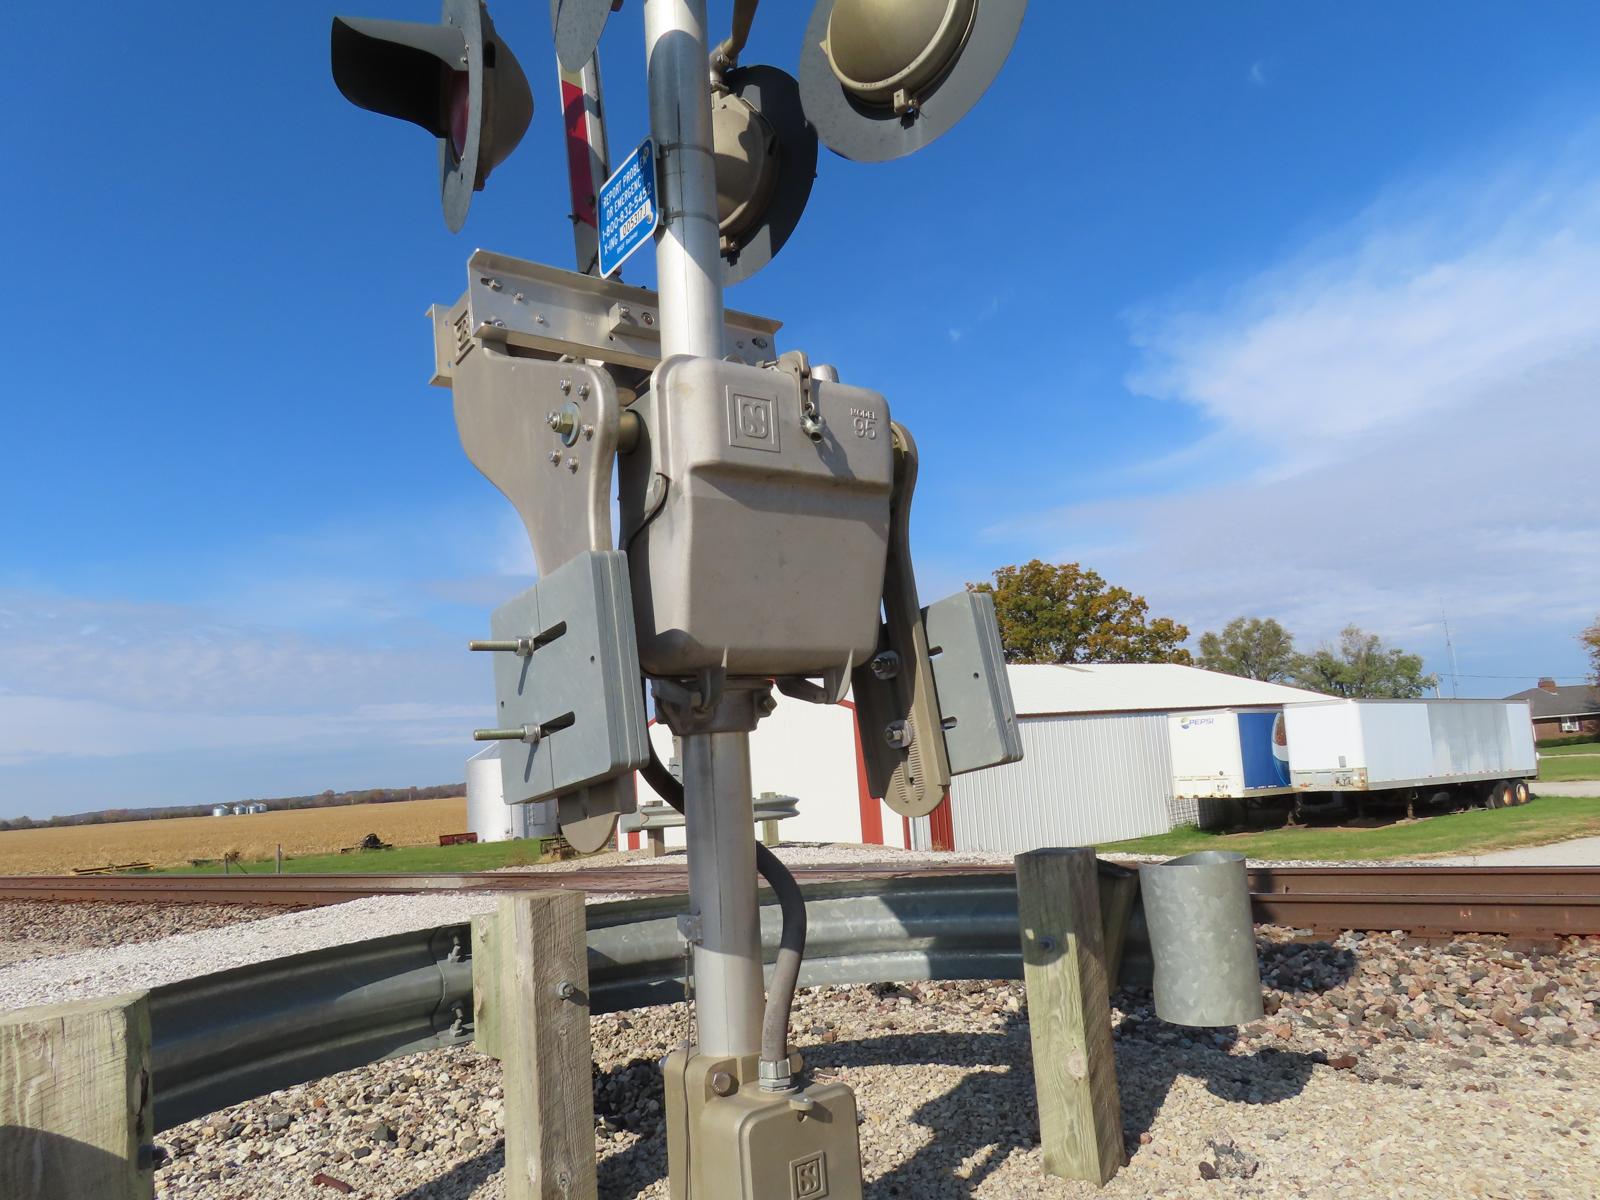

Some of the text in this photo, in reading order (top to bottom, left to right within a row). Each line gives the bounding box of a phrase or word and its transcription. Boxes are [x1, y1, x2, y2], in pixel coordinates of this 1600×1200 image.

[603, 180, 622, 208] REPORT
[602, 182, 651, 241] 1-800-832-5452
[607, 206, 614, 220] OR
[604, 233, 619, 256] X-ING
[850, 407, 877, 420] MODEL
[853, 417, 876, 440] 95
